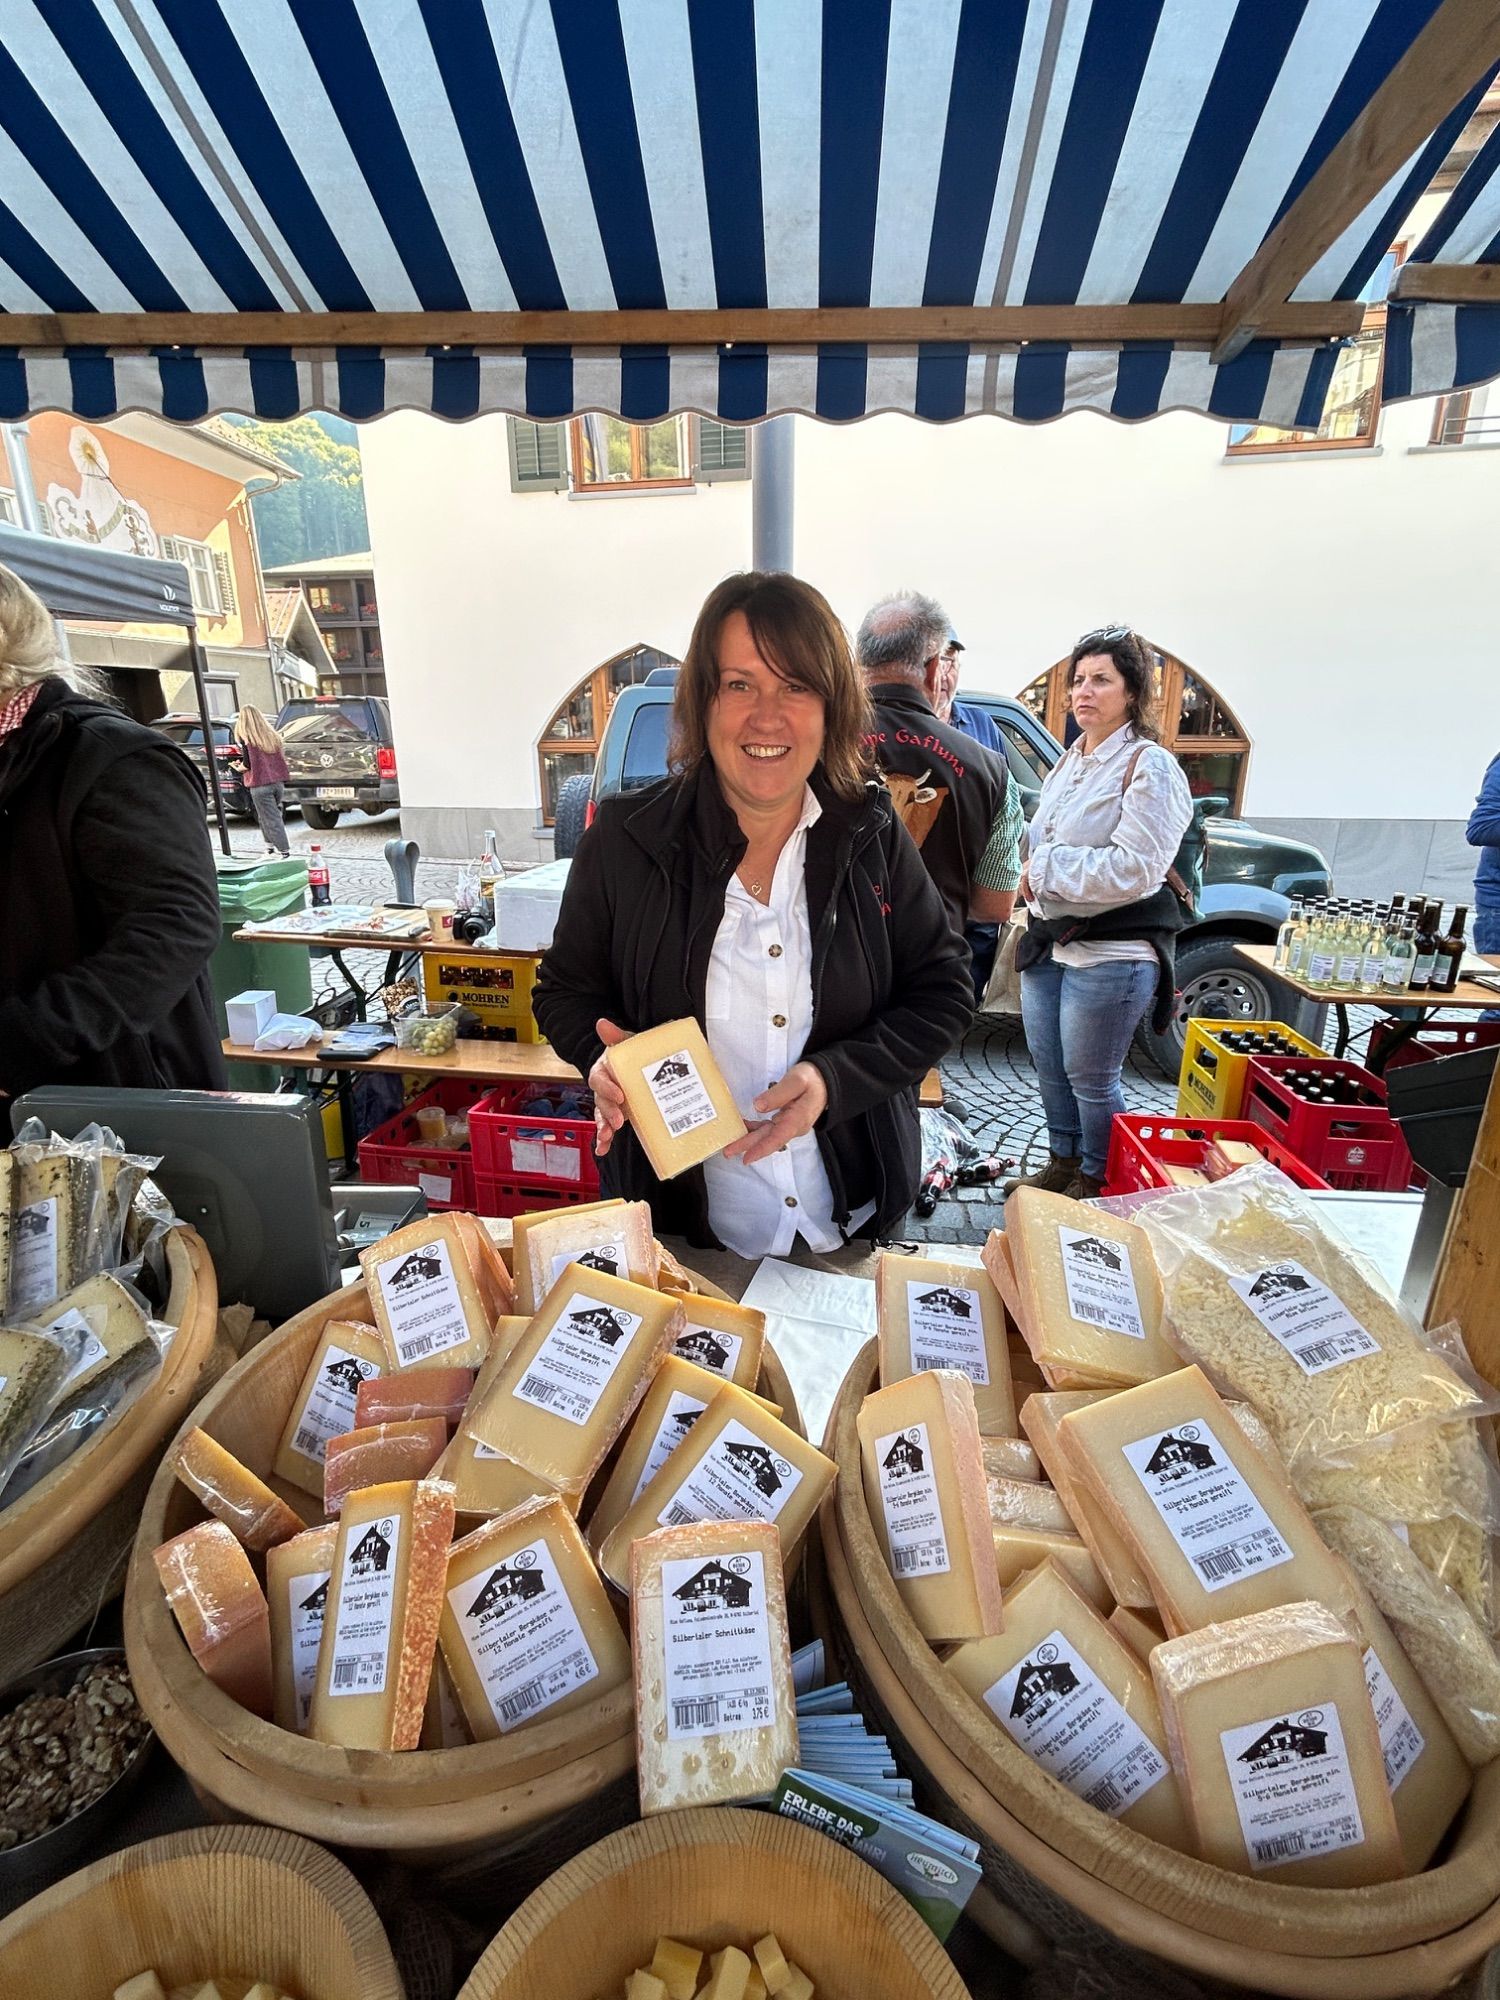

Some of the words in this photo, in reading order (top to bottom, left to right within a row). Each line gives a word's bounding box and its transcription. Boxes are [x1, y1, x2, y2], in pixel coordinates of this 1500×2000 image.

[895, 729, 965, 778] Gafluna
[462, 992, 510, 1004] MOHREN
[701, 1464, 733, 1491] Silbertaler
[731, 1489, 756, 1511] Bergkäse
[708, 1476, 716, 1485] 12
[714, 1482, 734, 1499] Monate
[732, 1497, 755, 1517] gereift
[1162, 1492, 1198, 1511] Silbertaler
[1198, 1482, 1225, 1498] Bergkäse
[1188, 1496, 1209, 1509] Monate
[1208, 1488, 1233, 1502] gereift
[477, 1627, 517, 1656] Silbertaler
[518, 1610, 547, 1633] Bergkäse
[493, 1645, 503, 1655] 12
[503, 1631, 526, 1649] Monate
[527, 1616, 552, 1635] gereift
[672, 1630, 712, 1643] Silbertaler
[715, 1624, 755, 1638] Schnittkäse
[1033, 1726, 1068, 1758] Silbertaler
[1065, 1704, 1093, 1730] Bergkäse
[1058, 1727, 1079, 1748] Monate
[1077, 1708, 1101, 1731] gereift
[1242, 1780, 1287, 1799] Silbertaler
[784, 1789, 836, 1825] ERLEBE
[836, 1816, 864, 1838] DAS
[910, 1853, 955, 1881] Heumilch
